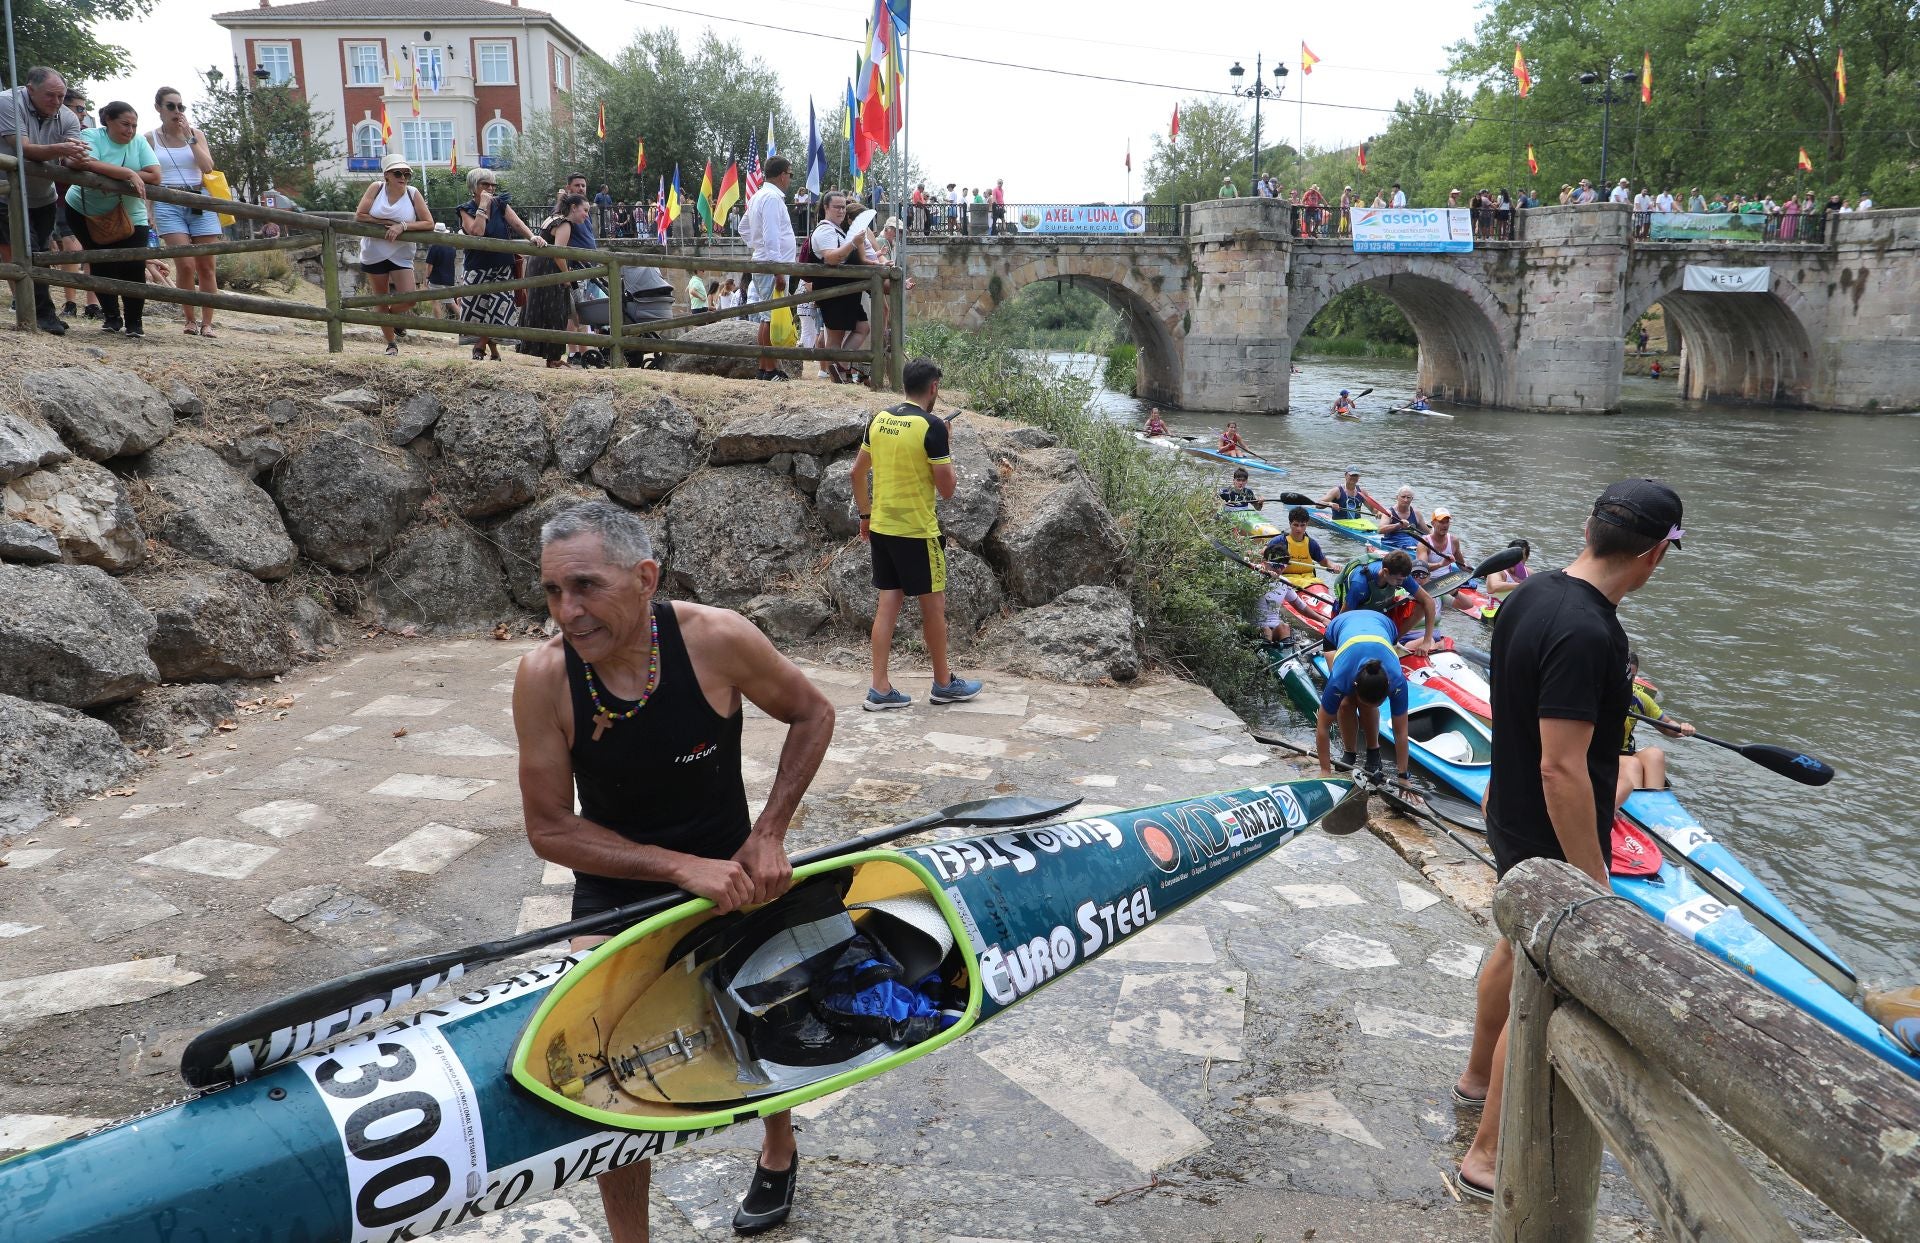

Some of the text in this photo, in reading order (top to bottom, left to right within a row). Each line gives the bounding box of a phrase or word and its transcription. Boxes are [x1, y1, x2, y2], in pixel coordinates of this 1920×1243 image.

[1045, 208, 1118, 223] AXEL Y LUNA
[1382, 210, 1439, 227] asenjo
[1711, 275, 1743, 284] META
[879, 425, 900, 436] Pravia
[1233, 799, 1282, 840] RSA 25
[915, 818, 1124, 881] EURO STEEL
[980, 887, 1157, 1006] EURO STEEL
[431, 1044, 445, 1056] 59
[466, 1124, 475, 1138] DEL
[314, 1041, 451, 1229] 300
[387, 1132, 665, 1243] KIKO VEGA
